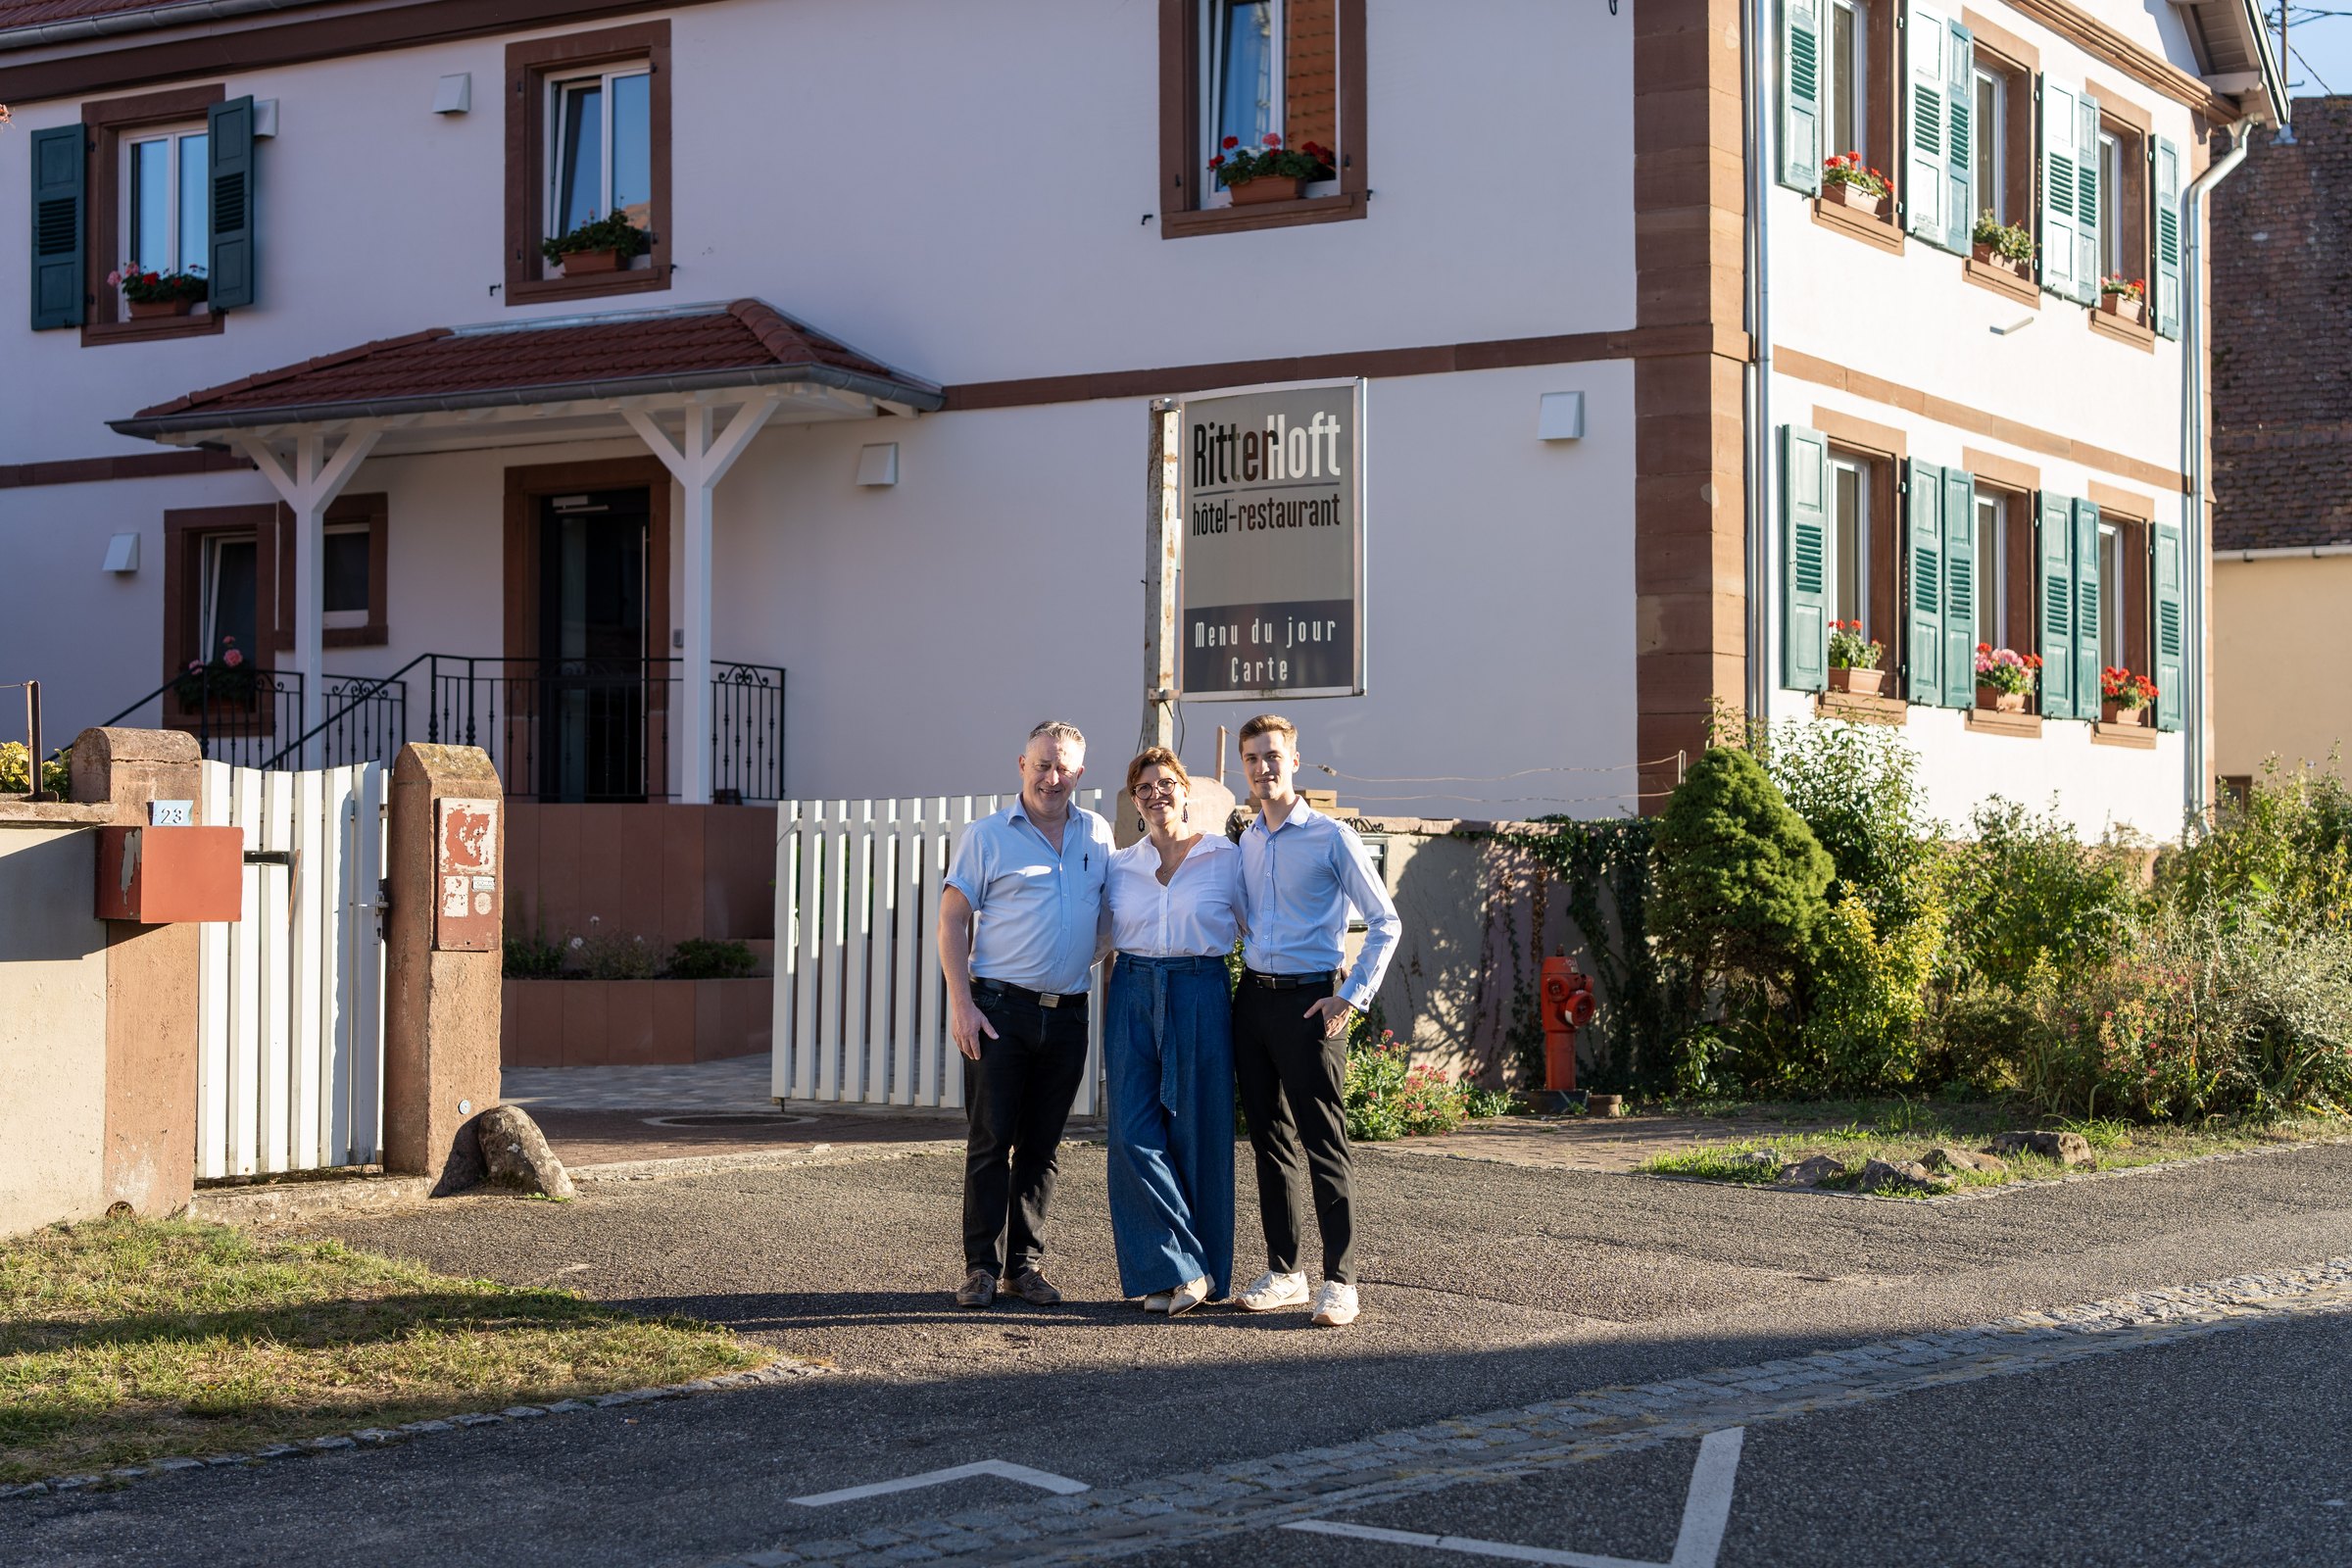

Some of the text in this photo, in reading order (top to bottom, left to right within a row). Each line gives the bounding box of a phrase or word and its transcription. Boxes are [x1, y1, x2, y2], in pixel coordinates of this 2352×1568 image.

[1193, 494, 1341, 536] hôtel-restaurant
[1195, 616, 1336, 649] Menu du jour
[1231, 657, 1288, 683] Carte
[161, 807, 184, 824] 23
